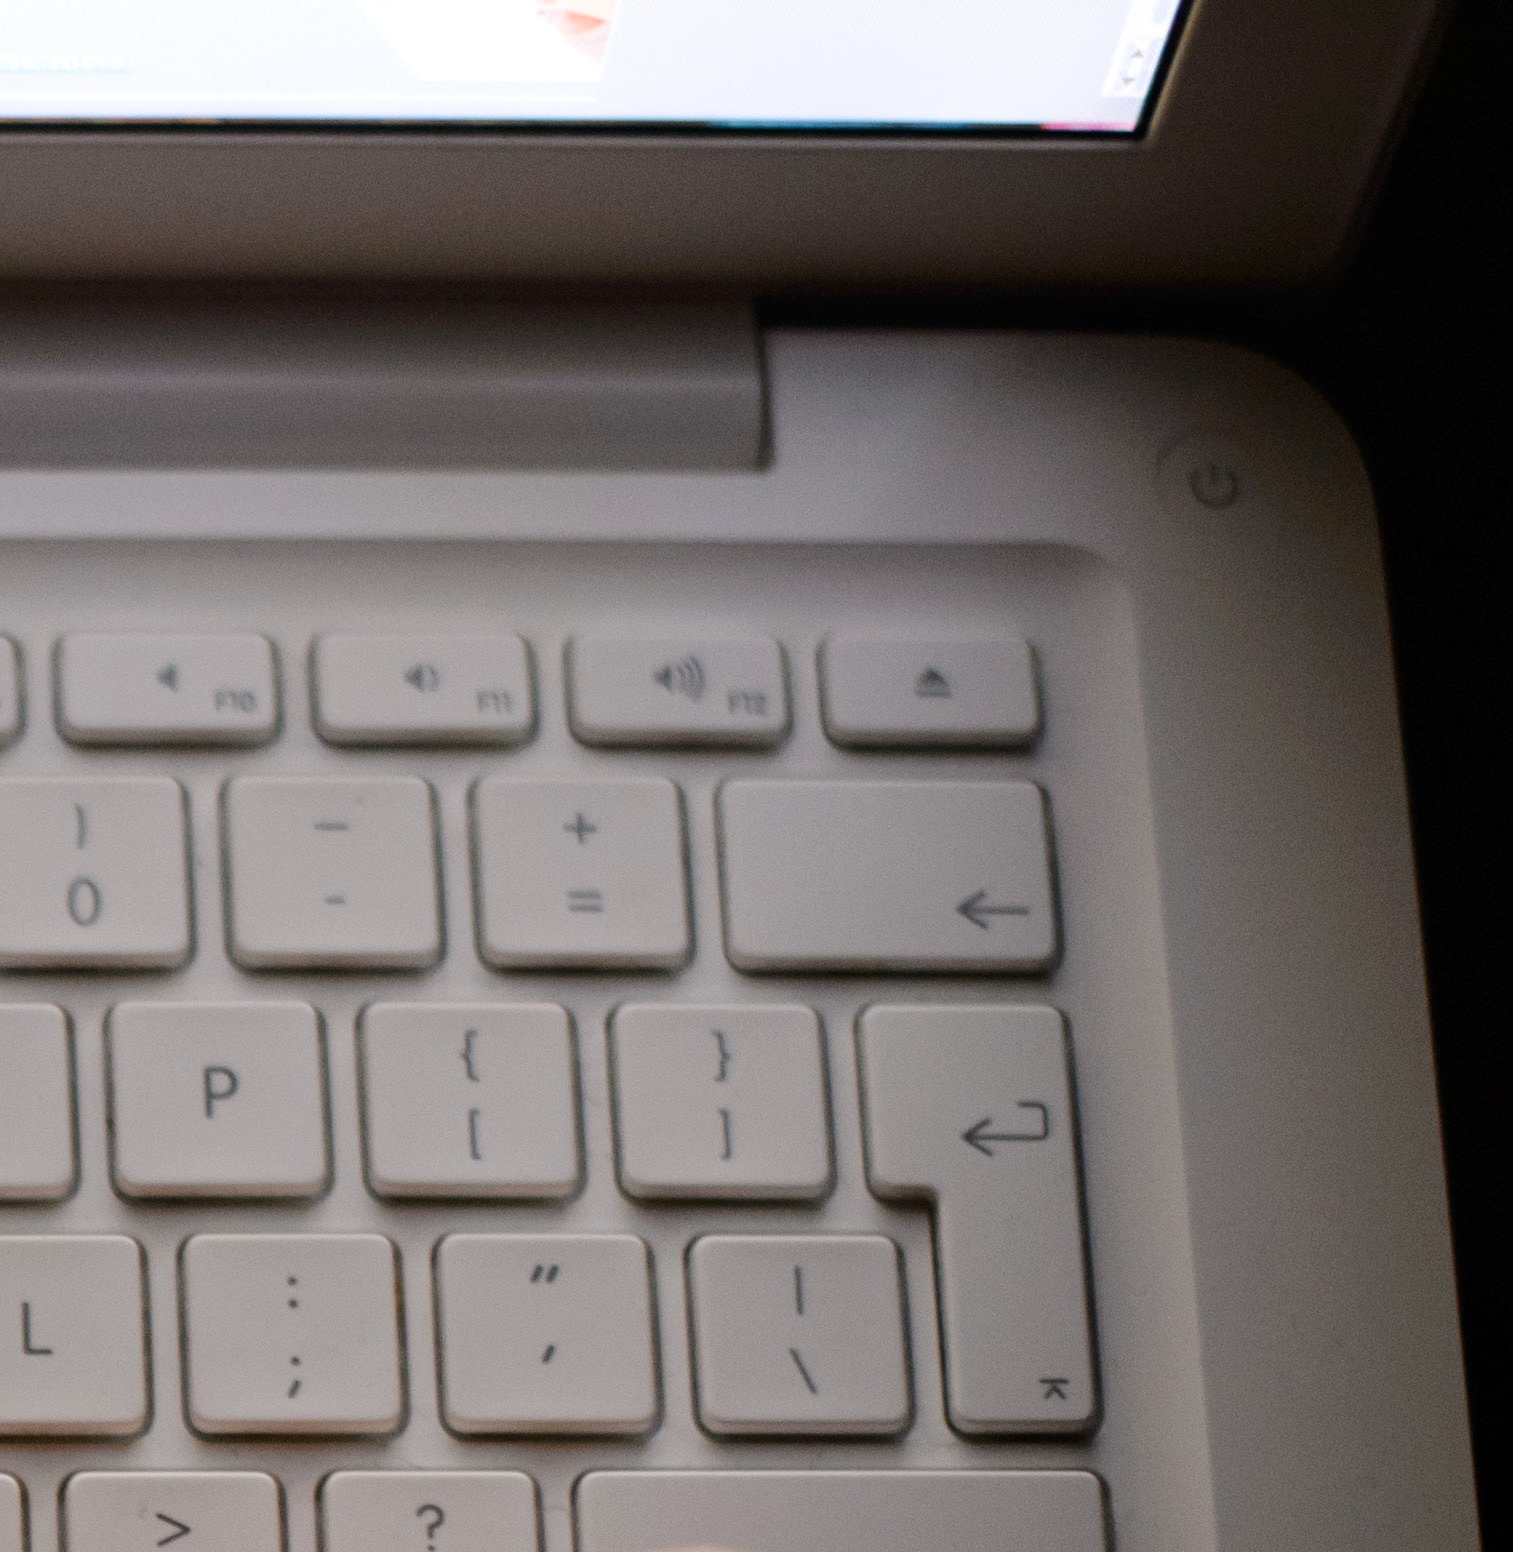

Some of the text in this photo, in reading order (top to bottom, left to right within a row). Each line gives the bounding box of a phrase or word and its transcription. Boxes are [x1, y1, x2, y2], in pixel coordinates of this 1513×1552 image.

[213, 689, 258, 714] F10
[475, 689, 514, 713] F11
[726, 689, 770, 717] F12
[74, 803, 89, 850] )
[564, 812, 598, 844] +
[65, 875, 104, 928] 0
[567, 888, 604, 914] =
[460, 1028, 479, 1083] {
[712, 1029, 732, 1083] }
[202, 1064, 240, 1119] P
[467, 1107, 482, 1161] [
[718, 1107, 734, 1161] ]
[286, 1275, 300, 1310] :
[20, 1301, 54, 1357] L
[287, 1355, 302, 1399] ;
[788, 1347, 819, 1395] \
[155, 1512, 192, 1548] >
[415, 1502, 446, 1552] ?
